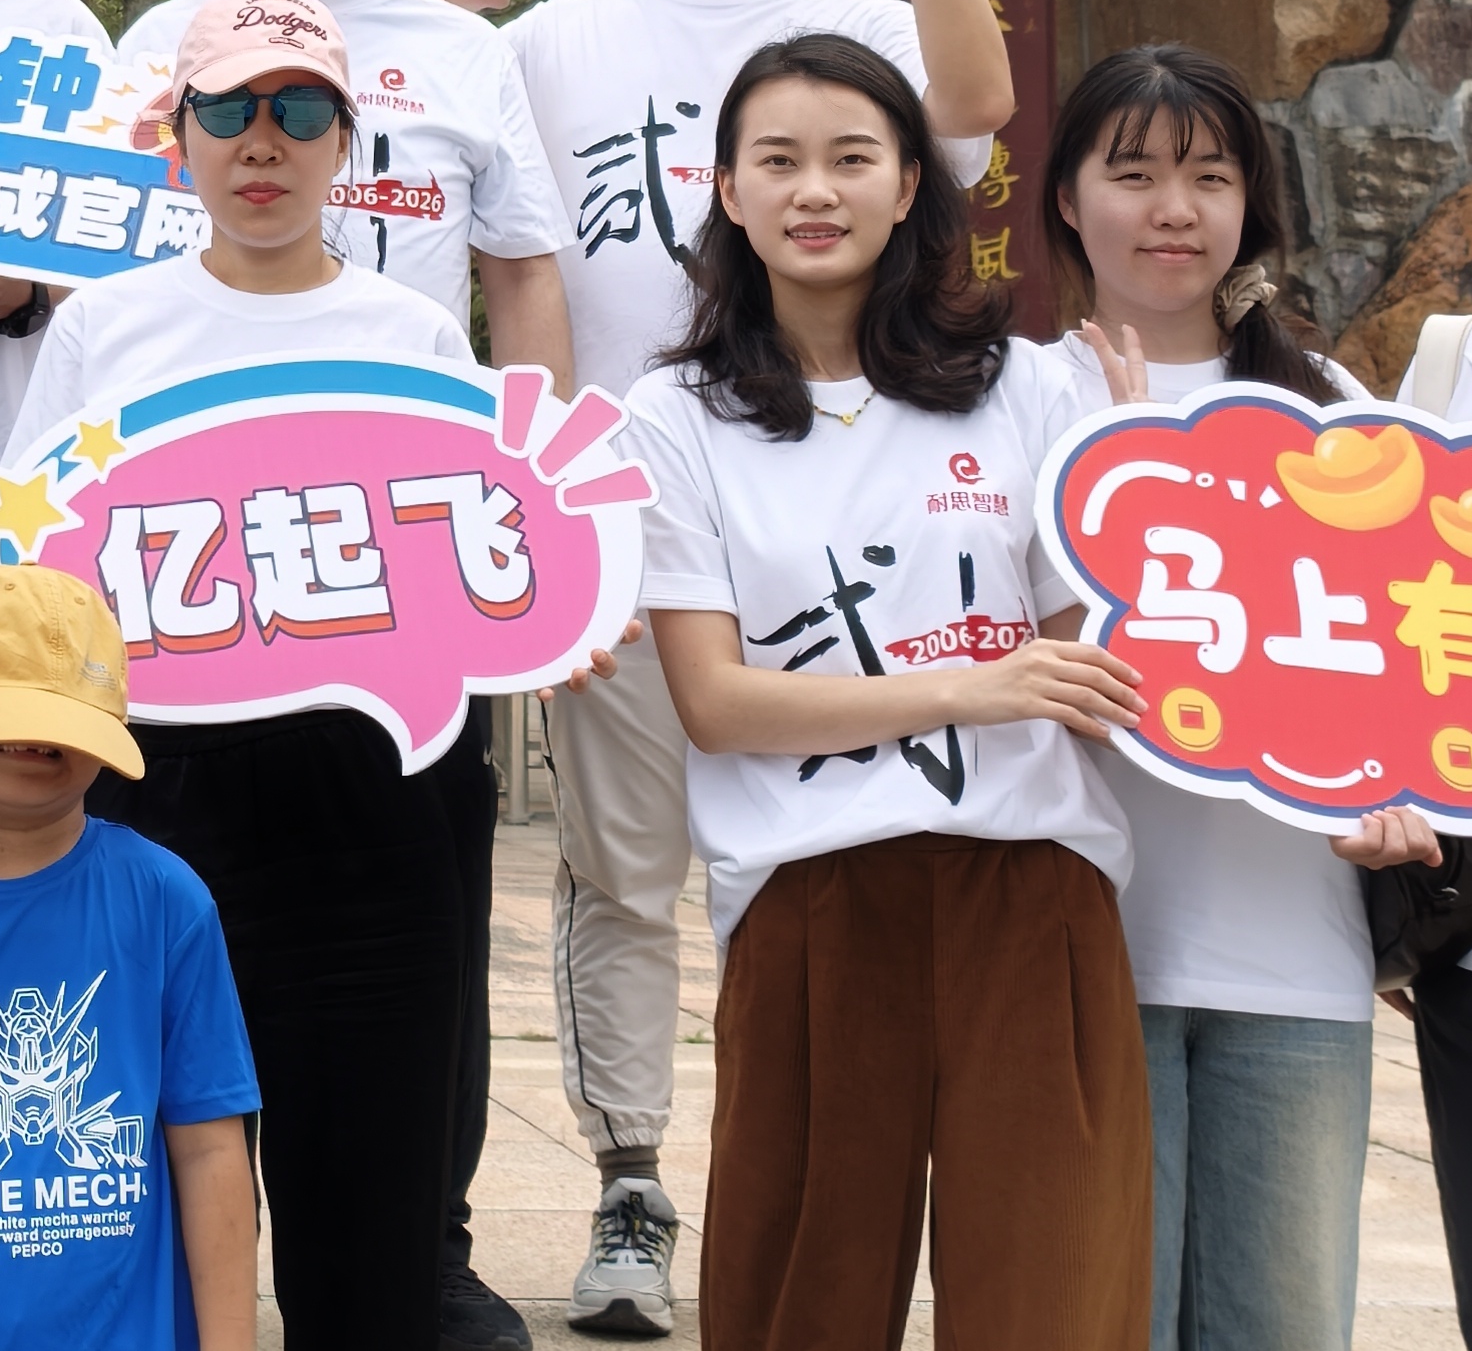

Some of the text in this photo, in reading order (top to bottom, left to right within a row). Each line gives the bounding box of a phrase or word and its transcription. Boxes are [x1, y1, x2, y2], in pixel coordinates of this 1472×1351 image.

[232, 5, 328, 41] Dodgers
[324, 186, 442, 213] 006-2026
[925, 491, 1010, 517] 耐思智慧
[99, 471, 534, 657] 亿起飞
[34, 1171, 149, 1210] MECH
[30, 1212, 79, 1228] mecha
[81, 1209, 132, 1225] warrior
[41, 1221, 136, 1241] courageously
[11, 1241, 63, 1259] PEPCO
